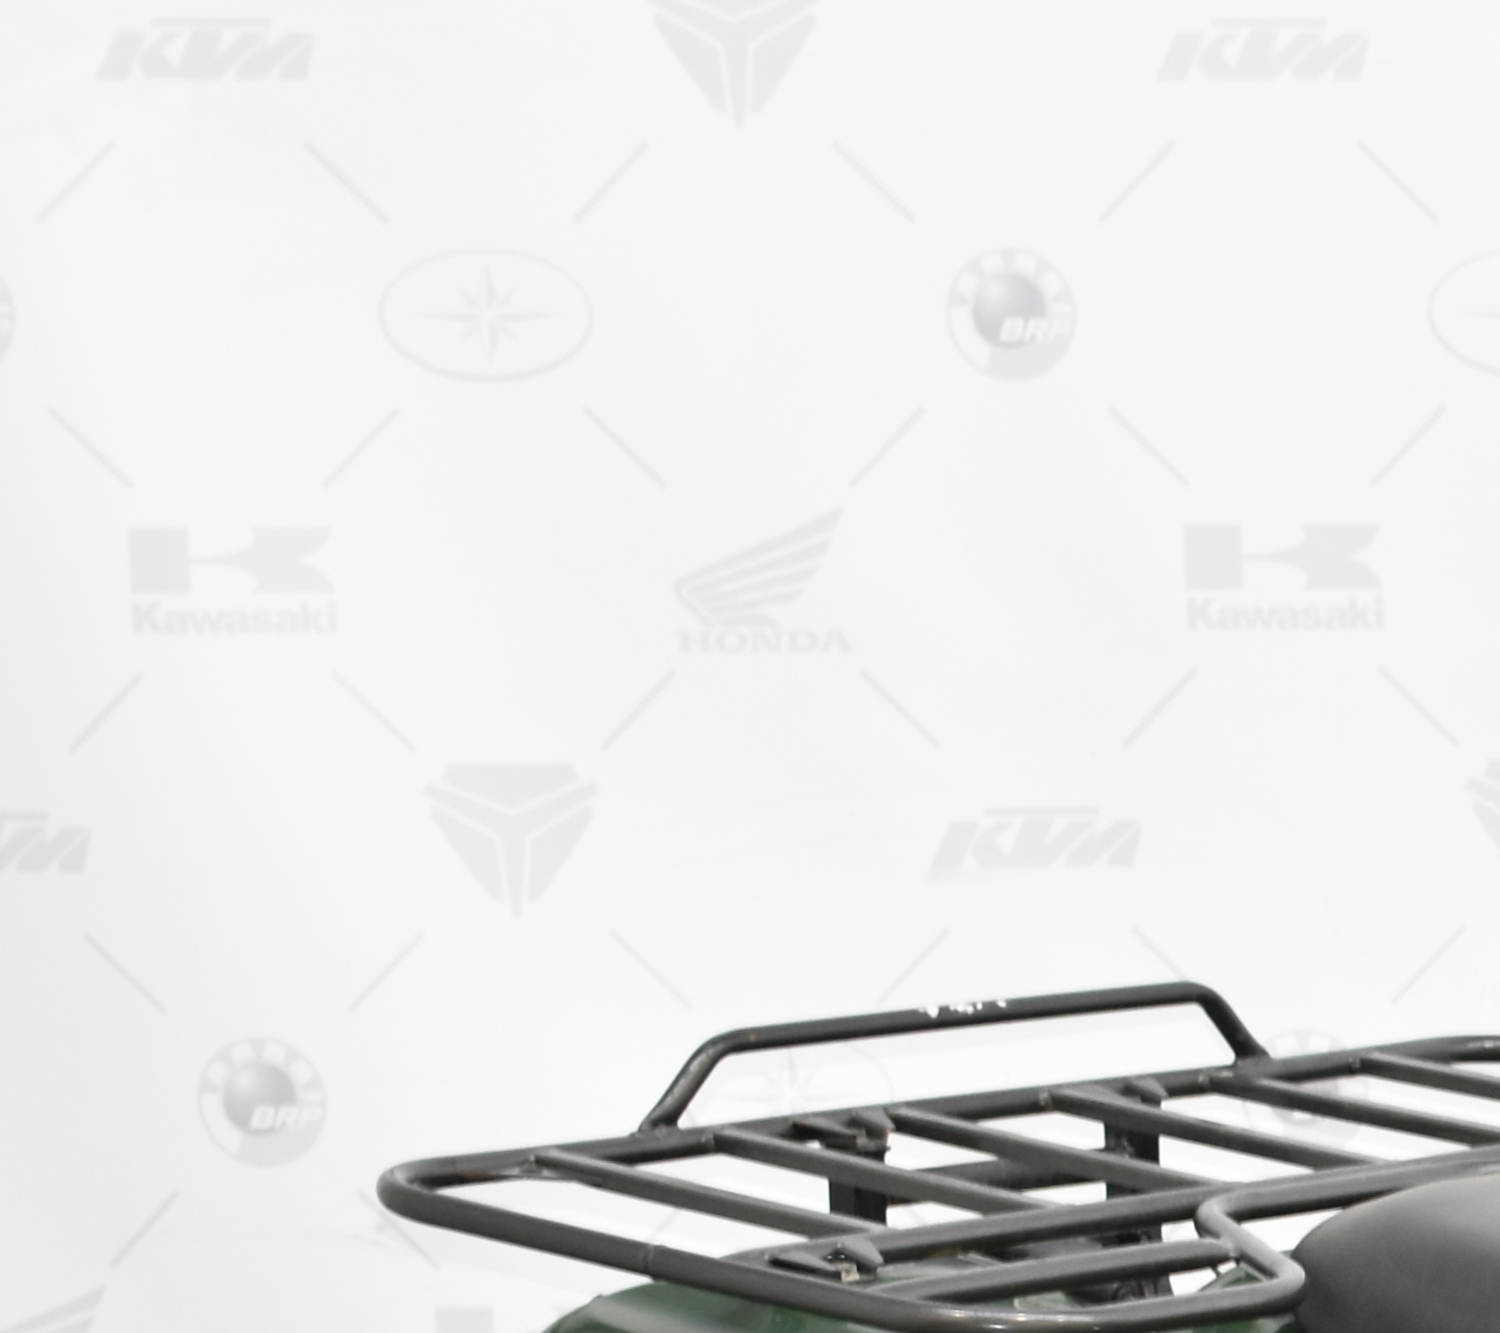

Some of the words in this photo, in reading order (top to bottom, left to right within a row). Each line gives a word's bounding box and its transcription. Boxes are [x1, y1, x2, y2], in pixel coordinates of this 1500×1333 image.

[97, 17, 315, 81] KTM
[1156, 17, 1370, 82] KTM
[1000, 318, 1073, 343] BRP
[129, 599, 337, 637] Kawasaki
[1186, 598, 1385, 631] Kawasaki
[677, 629, 857, 653] HONDA
[929, 805, 1144, 870] KTM
[251, 1104, 324, 1129] BRP
